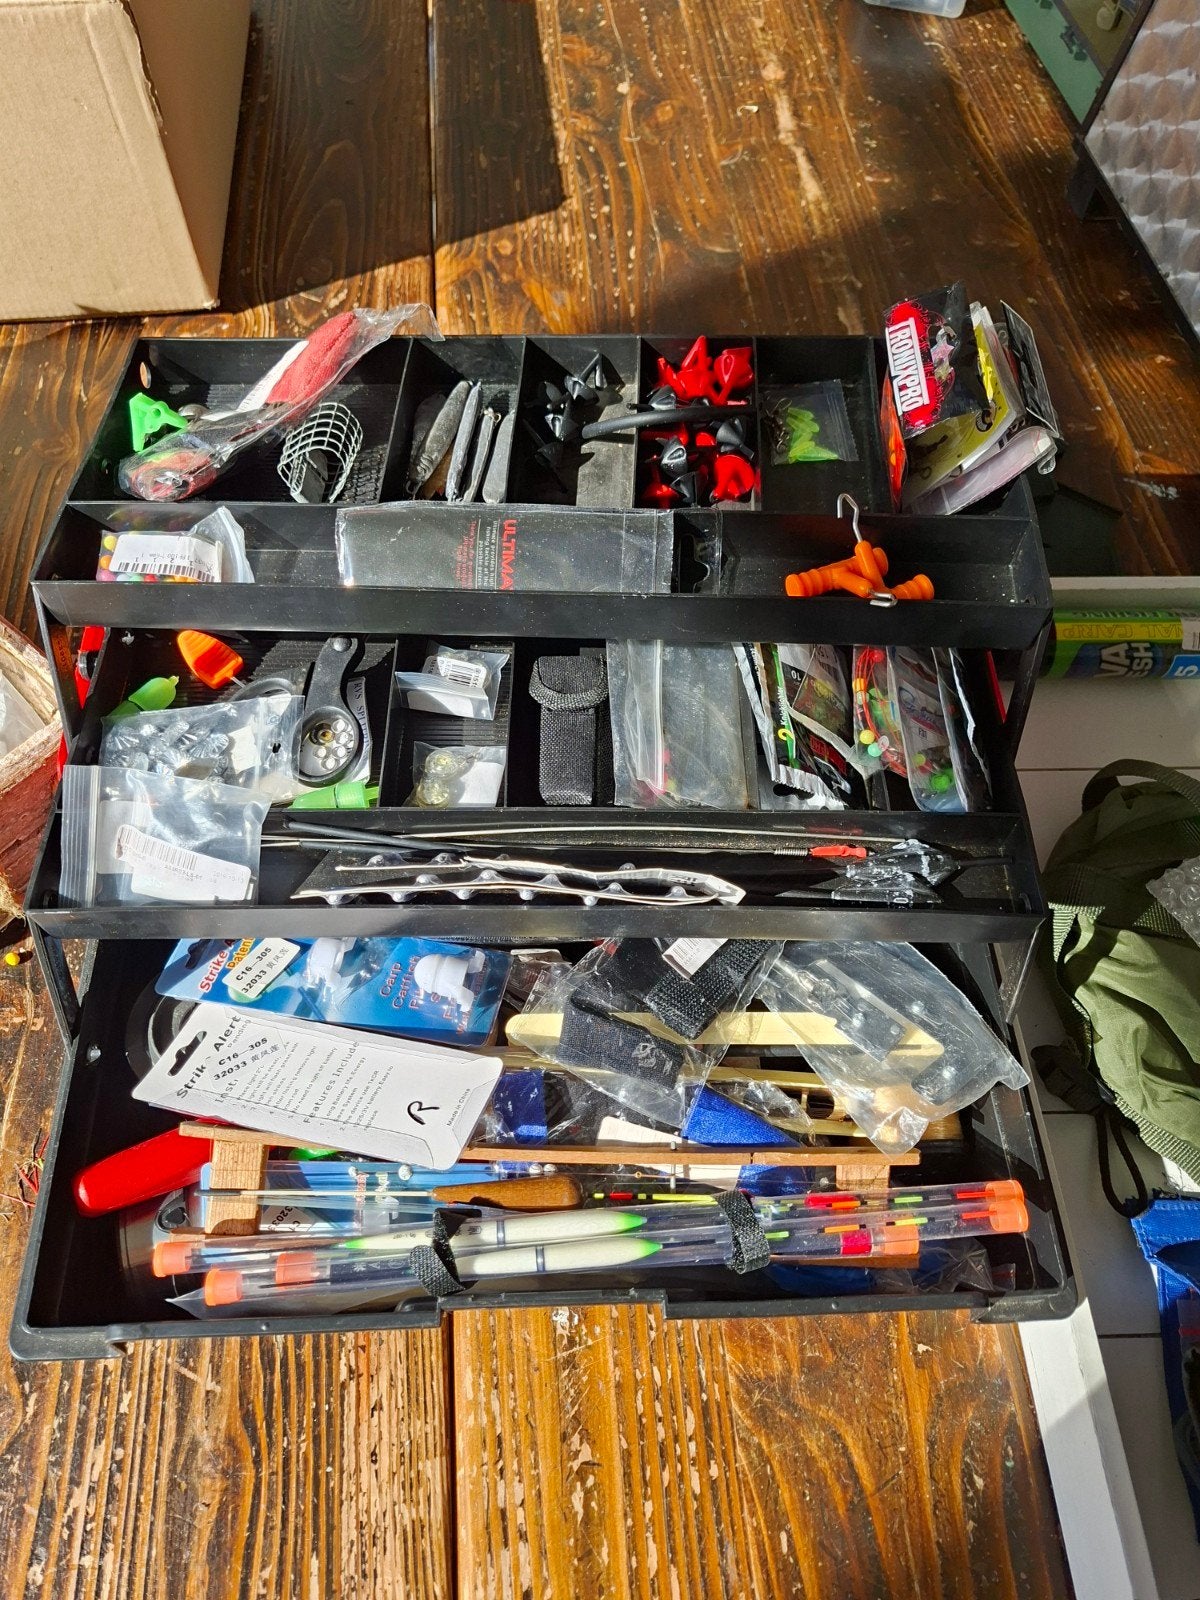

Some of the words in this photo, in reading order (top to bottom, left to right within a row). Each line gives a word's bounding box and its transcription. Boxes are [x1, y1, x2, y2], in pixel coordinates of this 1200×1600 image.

[885, 317, 930, 416] TRONIXPRO
[1063, 624, 1133, 638] CARP
[200, 950, 228, 992] Strike
[241, 969, 267, 993] 32033
[380, 962, 402, 997] Carp
[176, 1056, 211, 1098] Strik
[213, 1016, 241, 1052] Alert
[213, 1061, 247, 1081] 32033
[303, 1078, 337, 1125] Features
[332, 1040, 361, 1078] Include
